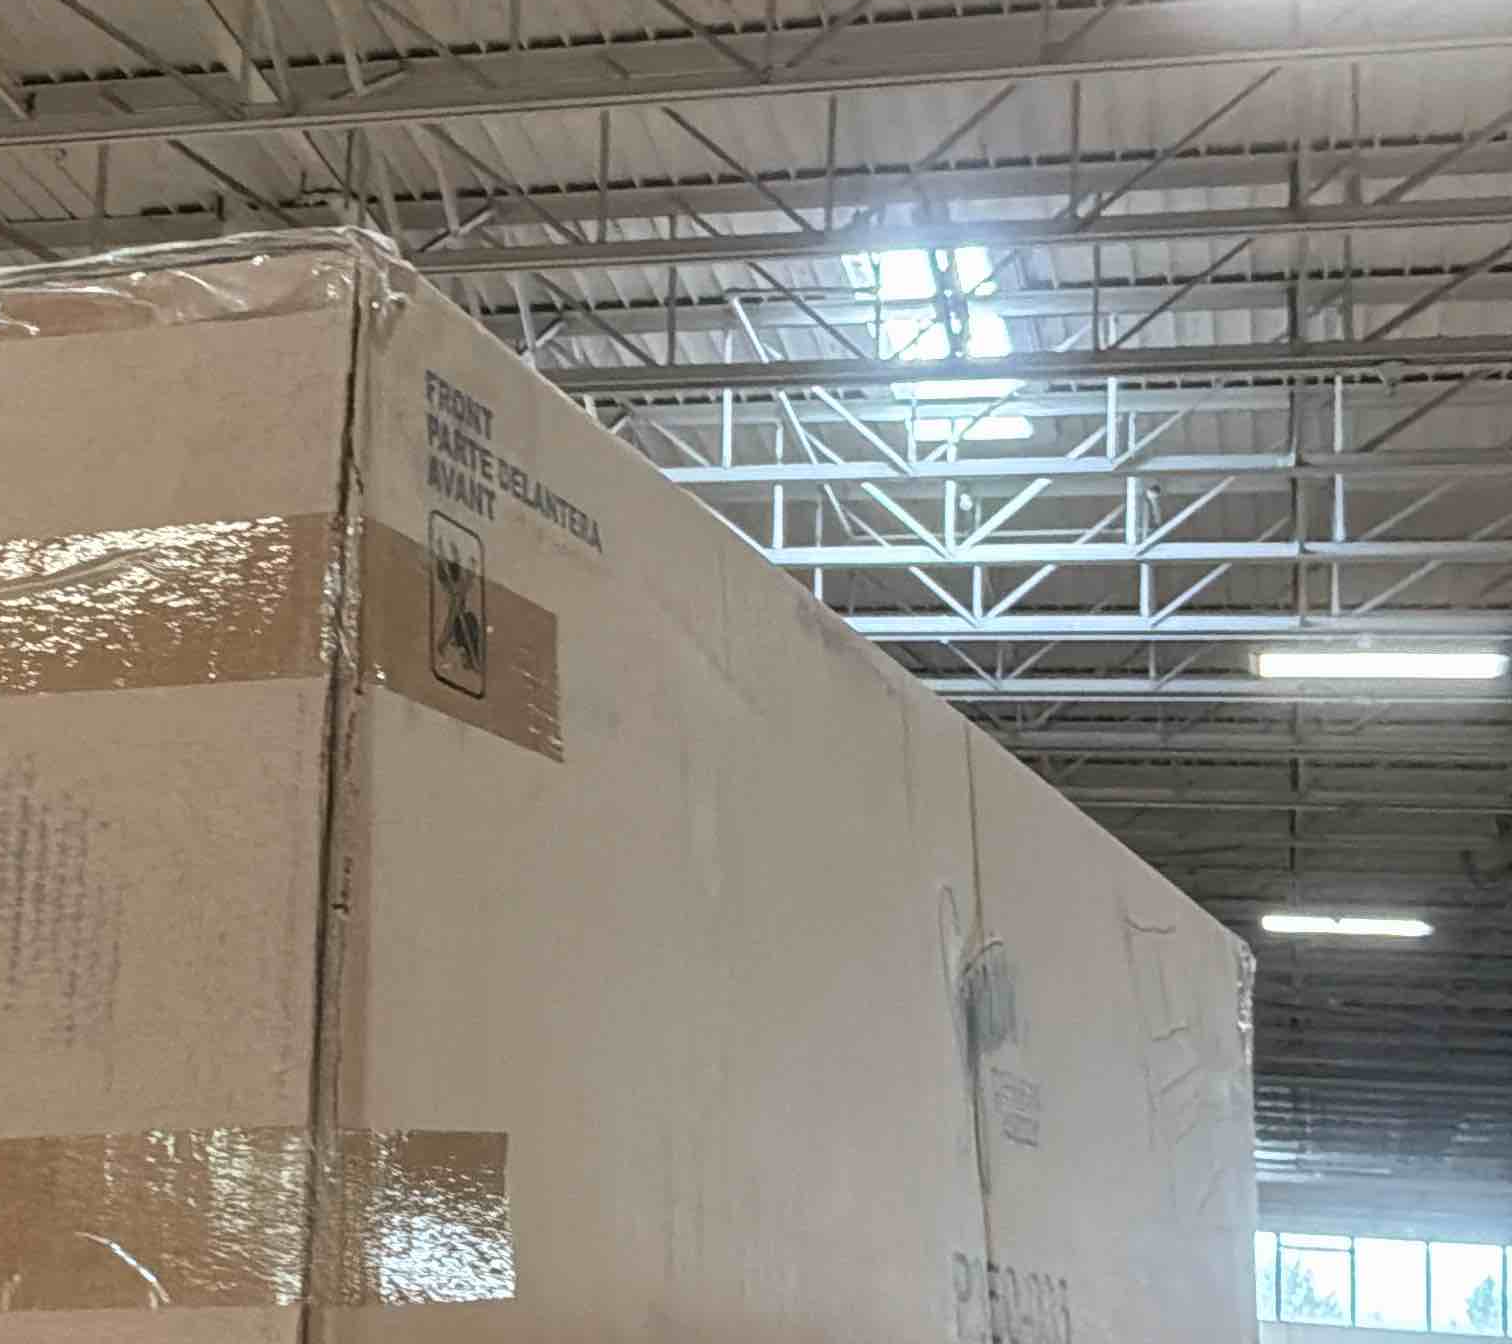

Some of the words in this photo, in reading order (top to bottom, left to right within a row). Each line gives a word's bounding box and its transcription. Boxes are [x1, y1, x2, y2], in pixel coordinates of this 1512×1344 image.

[425, 369, 494, 441] FRONT
[426, 413, 494, 481] PARTE
[498, 457, 603, 554] DELANTERA
[426, 455, 496, 521] AVANT
